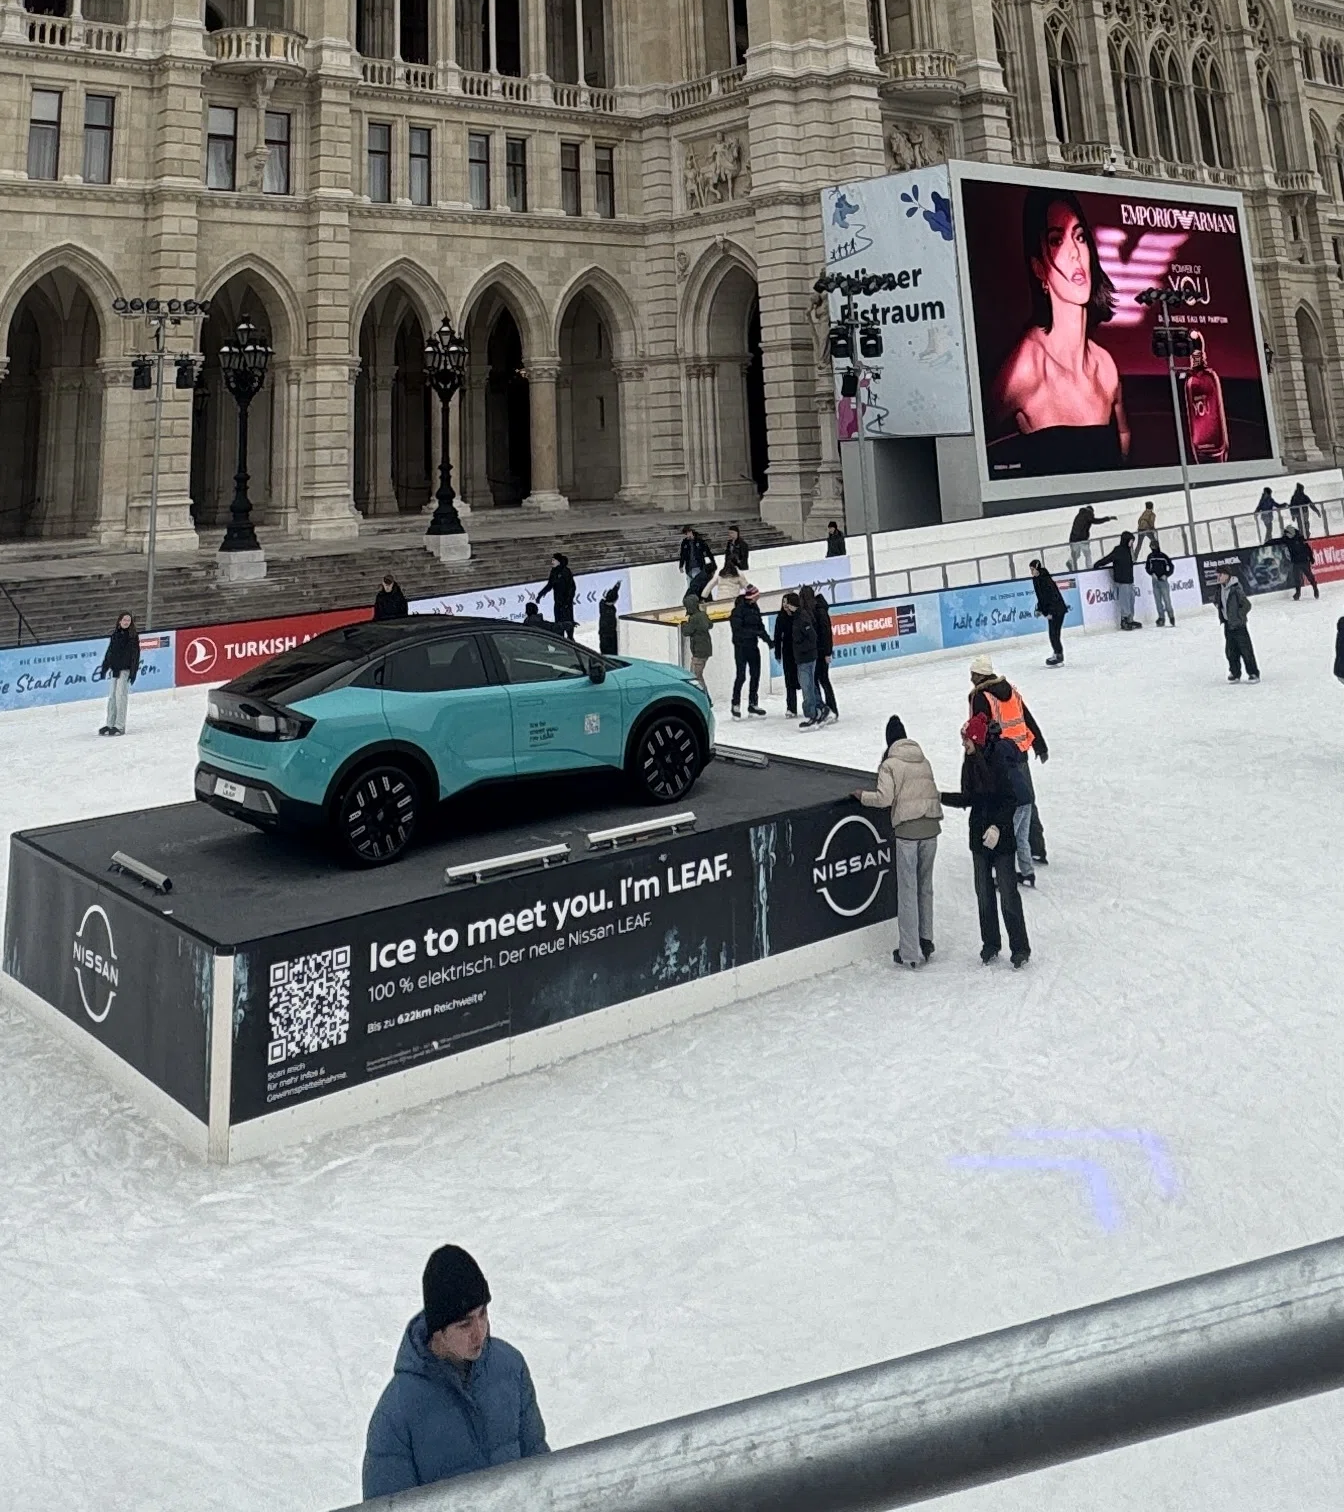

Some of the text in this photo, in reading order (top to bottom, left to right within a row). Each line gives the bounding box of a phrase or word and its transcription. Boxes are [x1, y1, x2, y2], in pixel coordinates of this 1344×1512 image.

[1120, 204, 1237, 234] EMPORIO ARMANI
[224, 636, 297, 660] TURKISH
[16, 671, 61, 694] Stadt
[65, 672, 87, 686] am
[813, 847, 892, 885] NISSAN
[369, 853, 733, 973] Ice to meet you. I'm LEAF.
[72, 940, 119, 987] NISSAN
[367, 911, 653, 1003] 100 % elektrisch. Der neue Nissan LEAF.
[367, 1021, 382, 1034] Bis
[383, 1018, 396, 1029] zu
[397, 1007, 432, 1025] 622km
